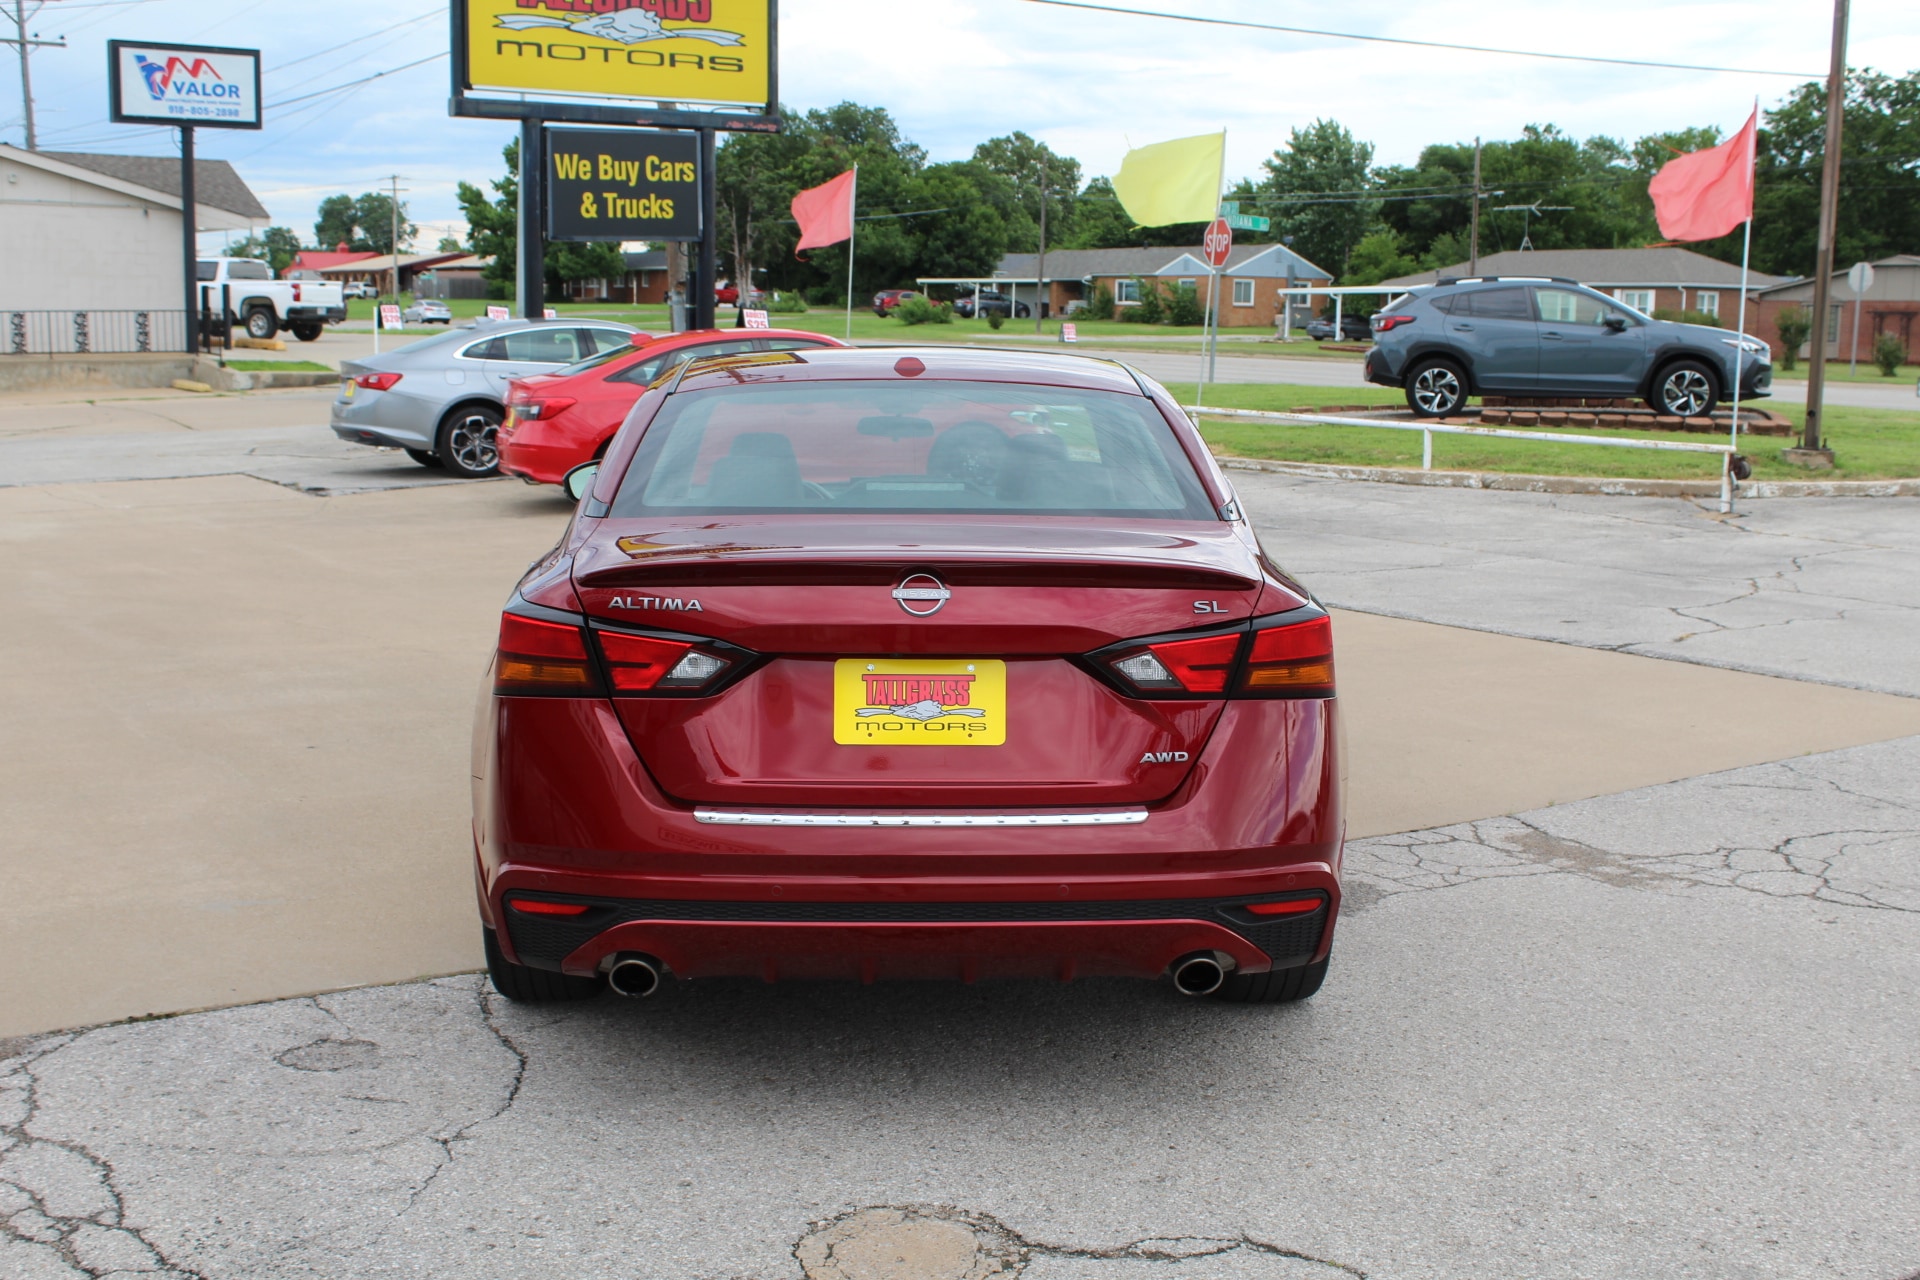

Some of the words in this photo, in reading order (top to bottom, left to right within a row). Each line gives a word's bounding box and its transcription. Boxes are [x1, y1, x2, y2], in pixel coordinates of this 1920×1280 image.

[496, 39, 744, 72] MOTORS
[173, 81, 240, 98] VALOR
[554, 153, 592, 180] We
[598, 154, 640, 187] Buy
[645, 155, 695, 183] Cars
[580, 192, 597, 218] &
[602, 192, 674, 219] Trucks
[1205, 234, 1229, 252] STOP
[893, 589, 950, 598] NISSAN
[607, 596, 704, 612] ALTIMA
[1193, 600, 1229, 613] SL
[862, 674, 976, 706] TALLGRASS
[855, 722, 987, 731] MOTORS
[1139, 751, 1189, 763] AWD
